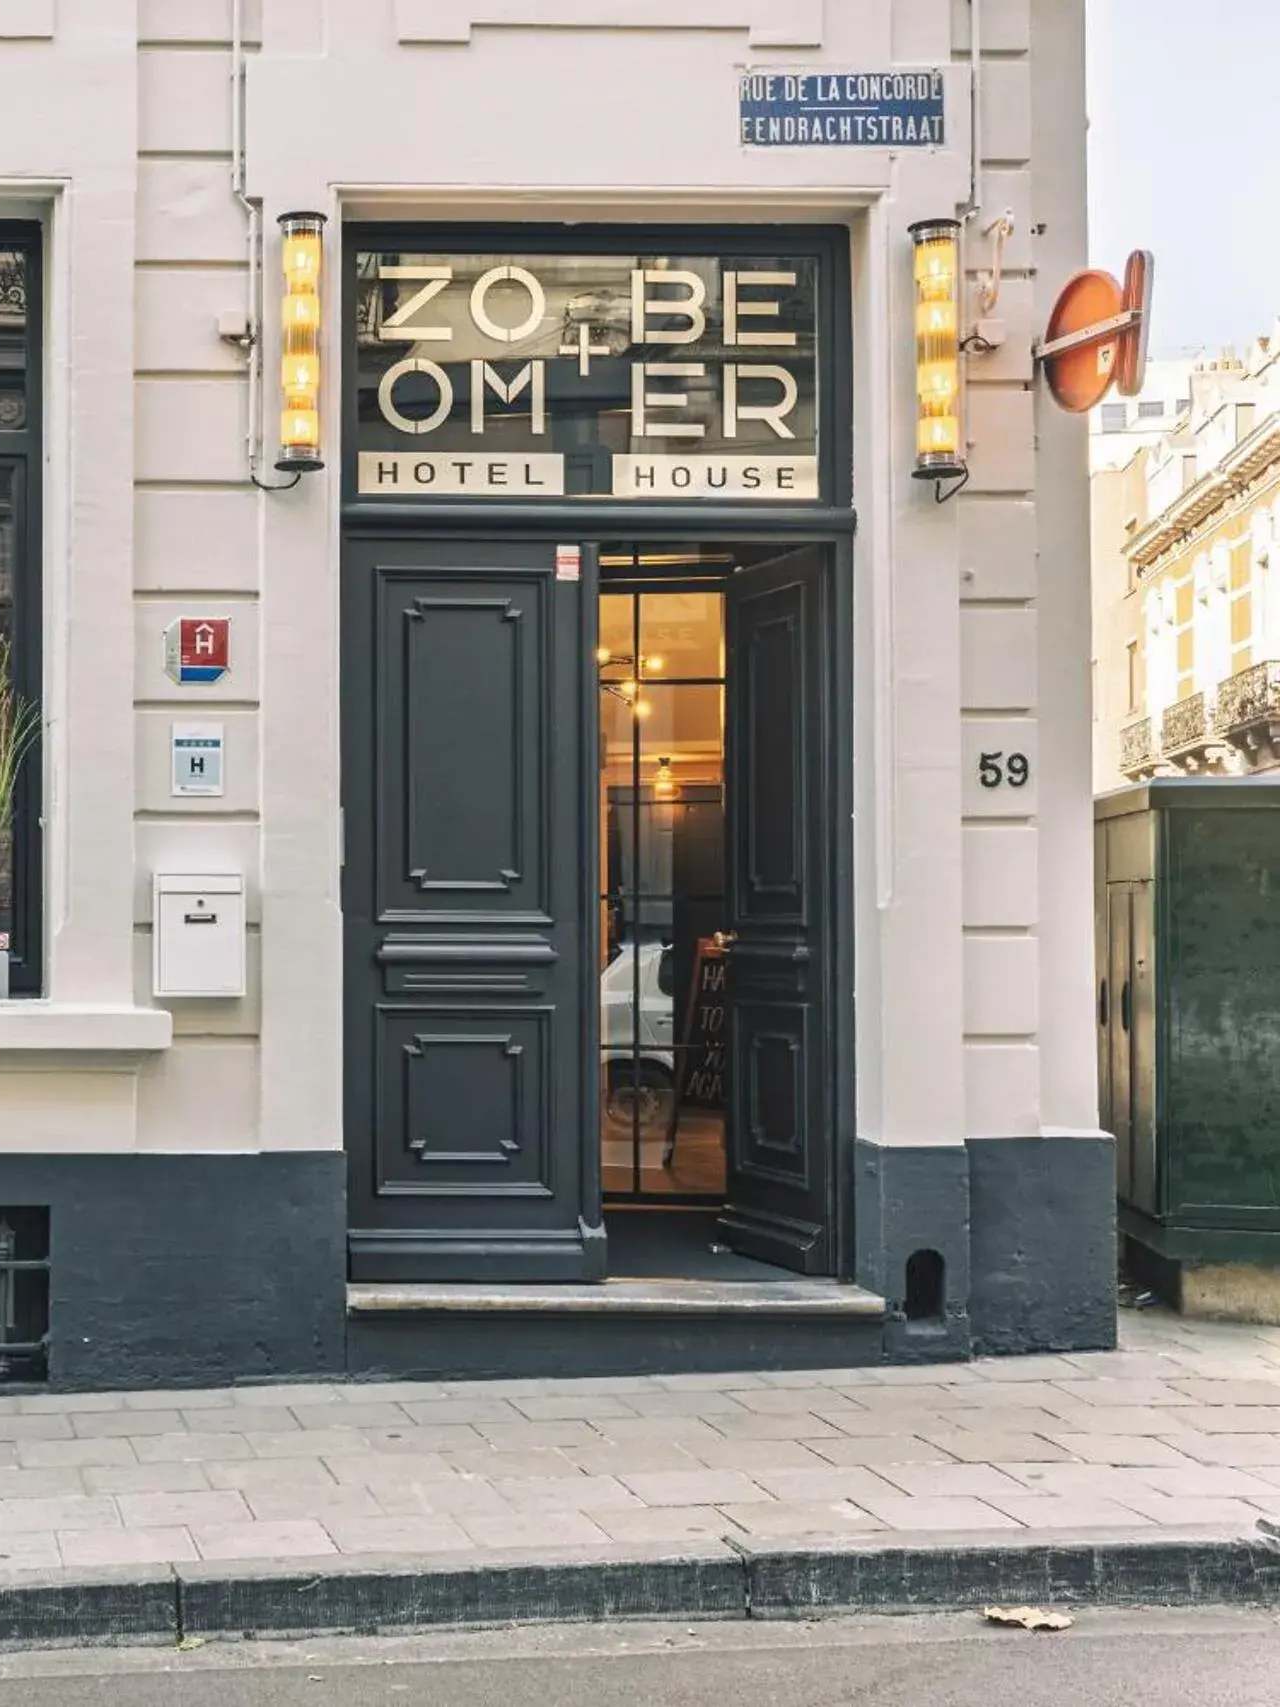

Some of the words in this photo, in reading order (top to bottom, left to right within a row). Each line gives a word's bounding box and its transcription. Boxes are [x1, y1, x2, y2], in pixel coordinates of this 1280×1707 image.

[739, 75, 777, 101] RUE
[784, 75, 808, 101] DE
[817, 76, 840, 101] LA
[845, 74, 941, 100] CONCORDE
[741, 115, 943, 142] EENDRACHTSTRAAT
[378, 266, 546, 342] ZO
[631, 269, 797, 346] BE
[378, 358, 545, 435] OM
[631, 363, 798, 440] ER
[377, 461, 545, 486] HOTEL
[634, 466, 796, 490] HOUSE
[190, 756, 204, 773] H
[979, 751, 1029, 787] 59
